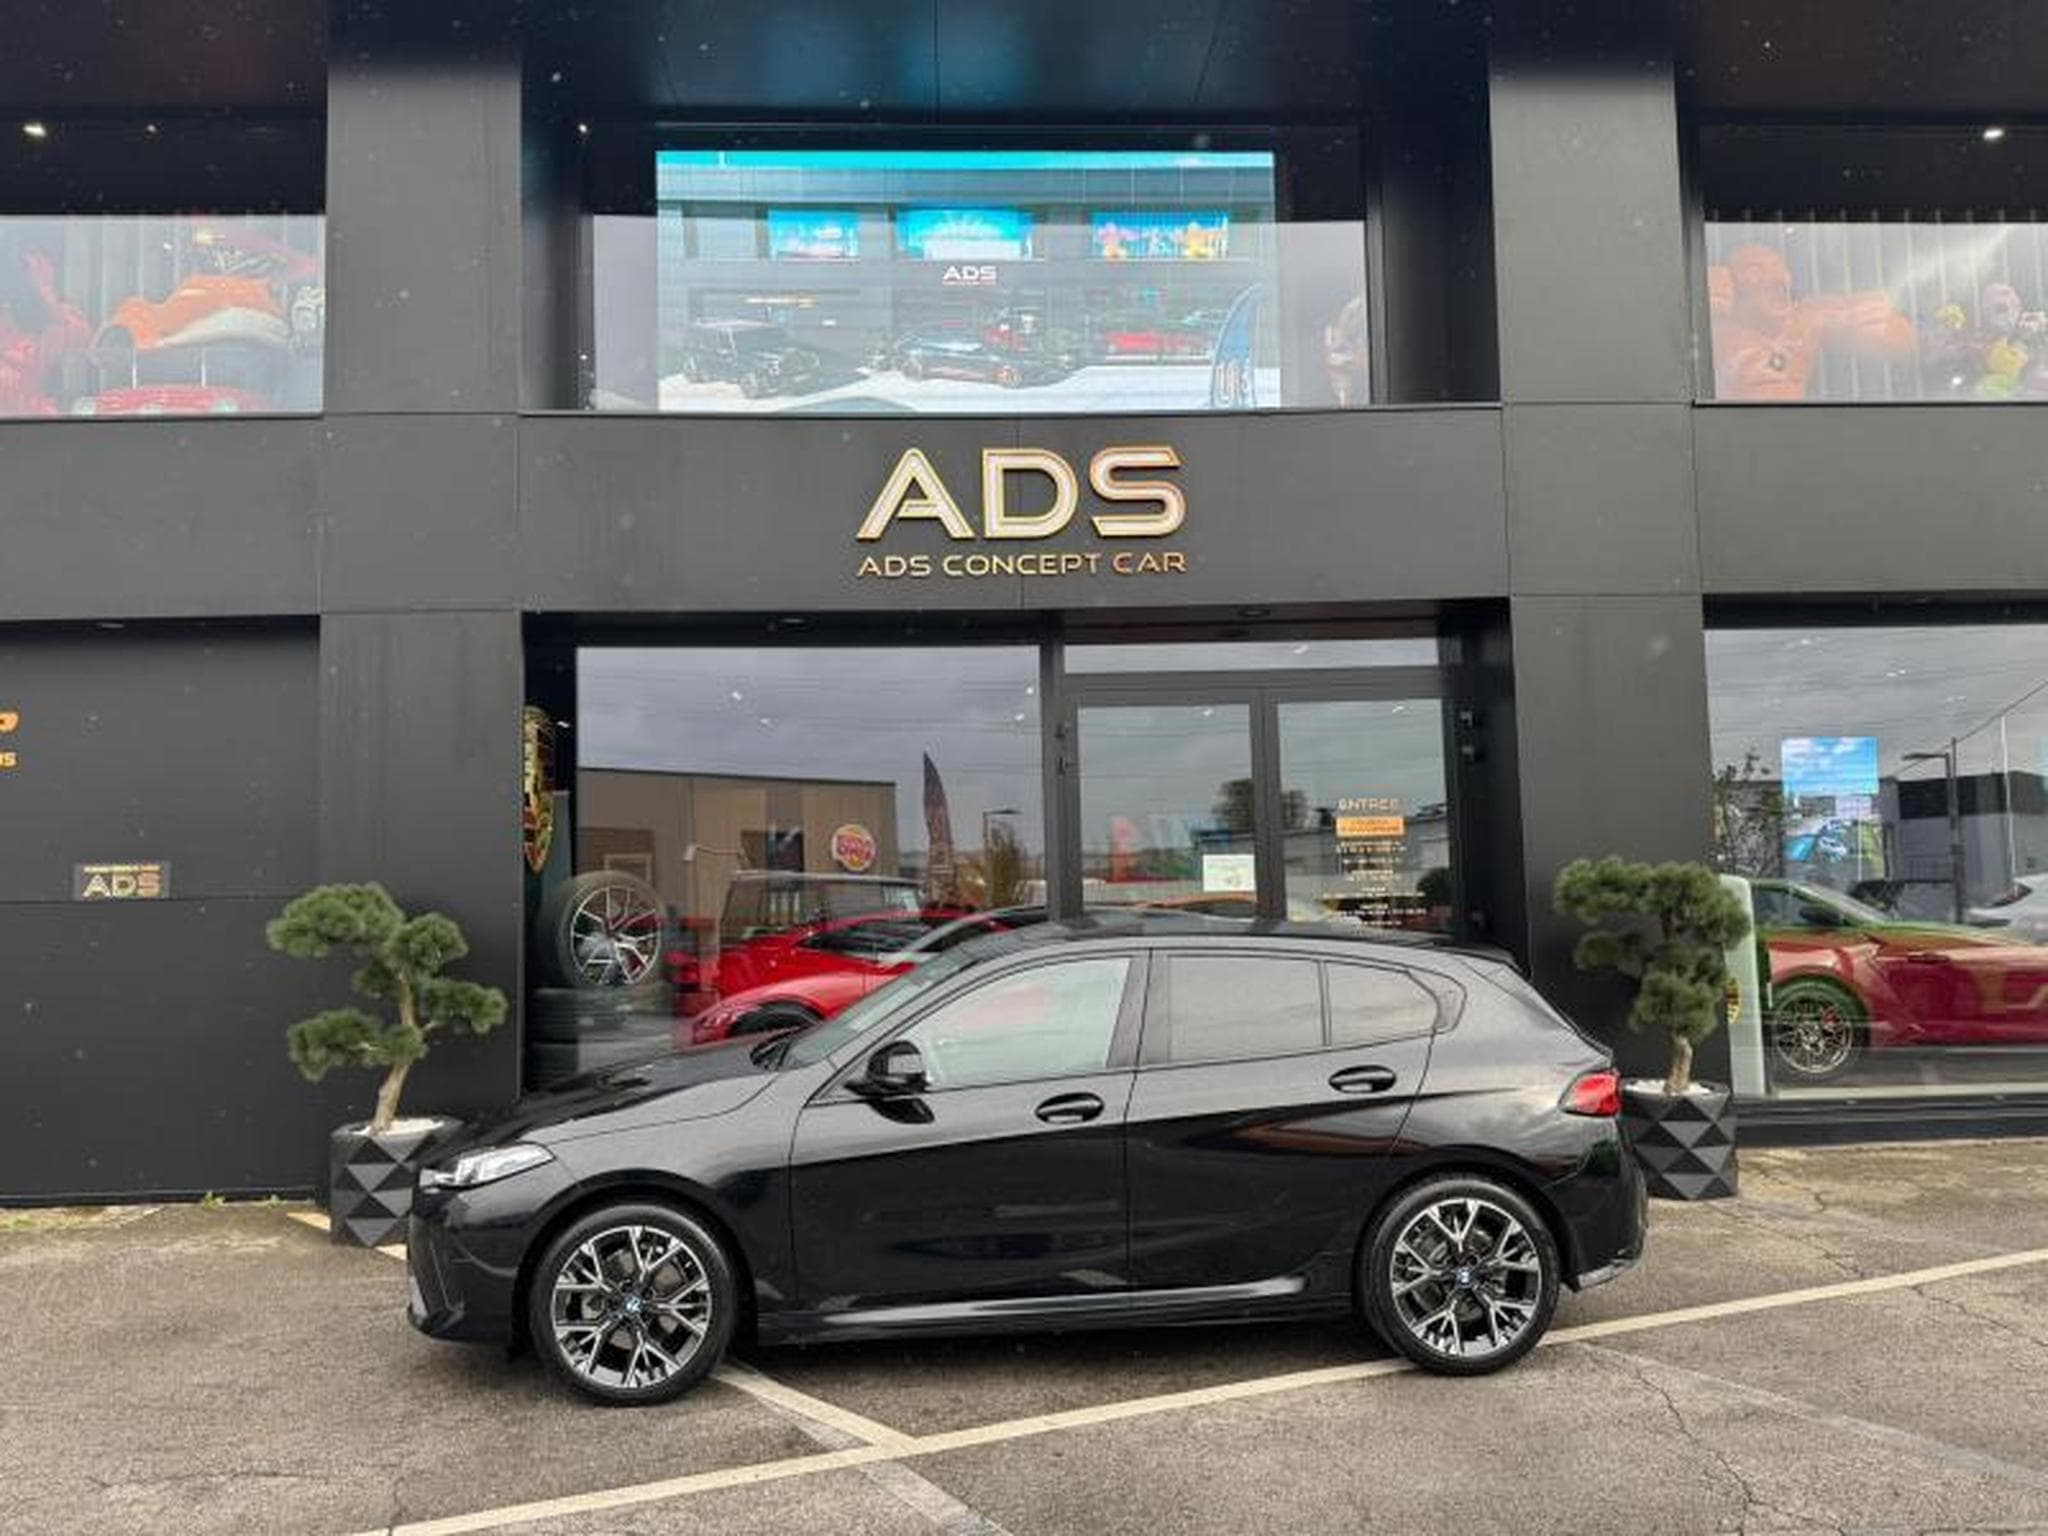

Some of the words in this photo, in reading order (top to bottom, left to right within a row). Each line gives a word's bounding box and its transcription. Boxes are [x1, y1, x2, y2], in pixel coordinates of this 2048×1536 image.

[943, 265, 997, 281] ADS
[857, 446, 1187, 539] ADS
[857, 556, 932, 578] ADS
[943, 553, 1101, 577] CONCEPT
[1112, 552, 1187, 574] CAR
[82, 874, 162, 897] ADS
